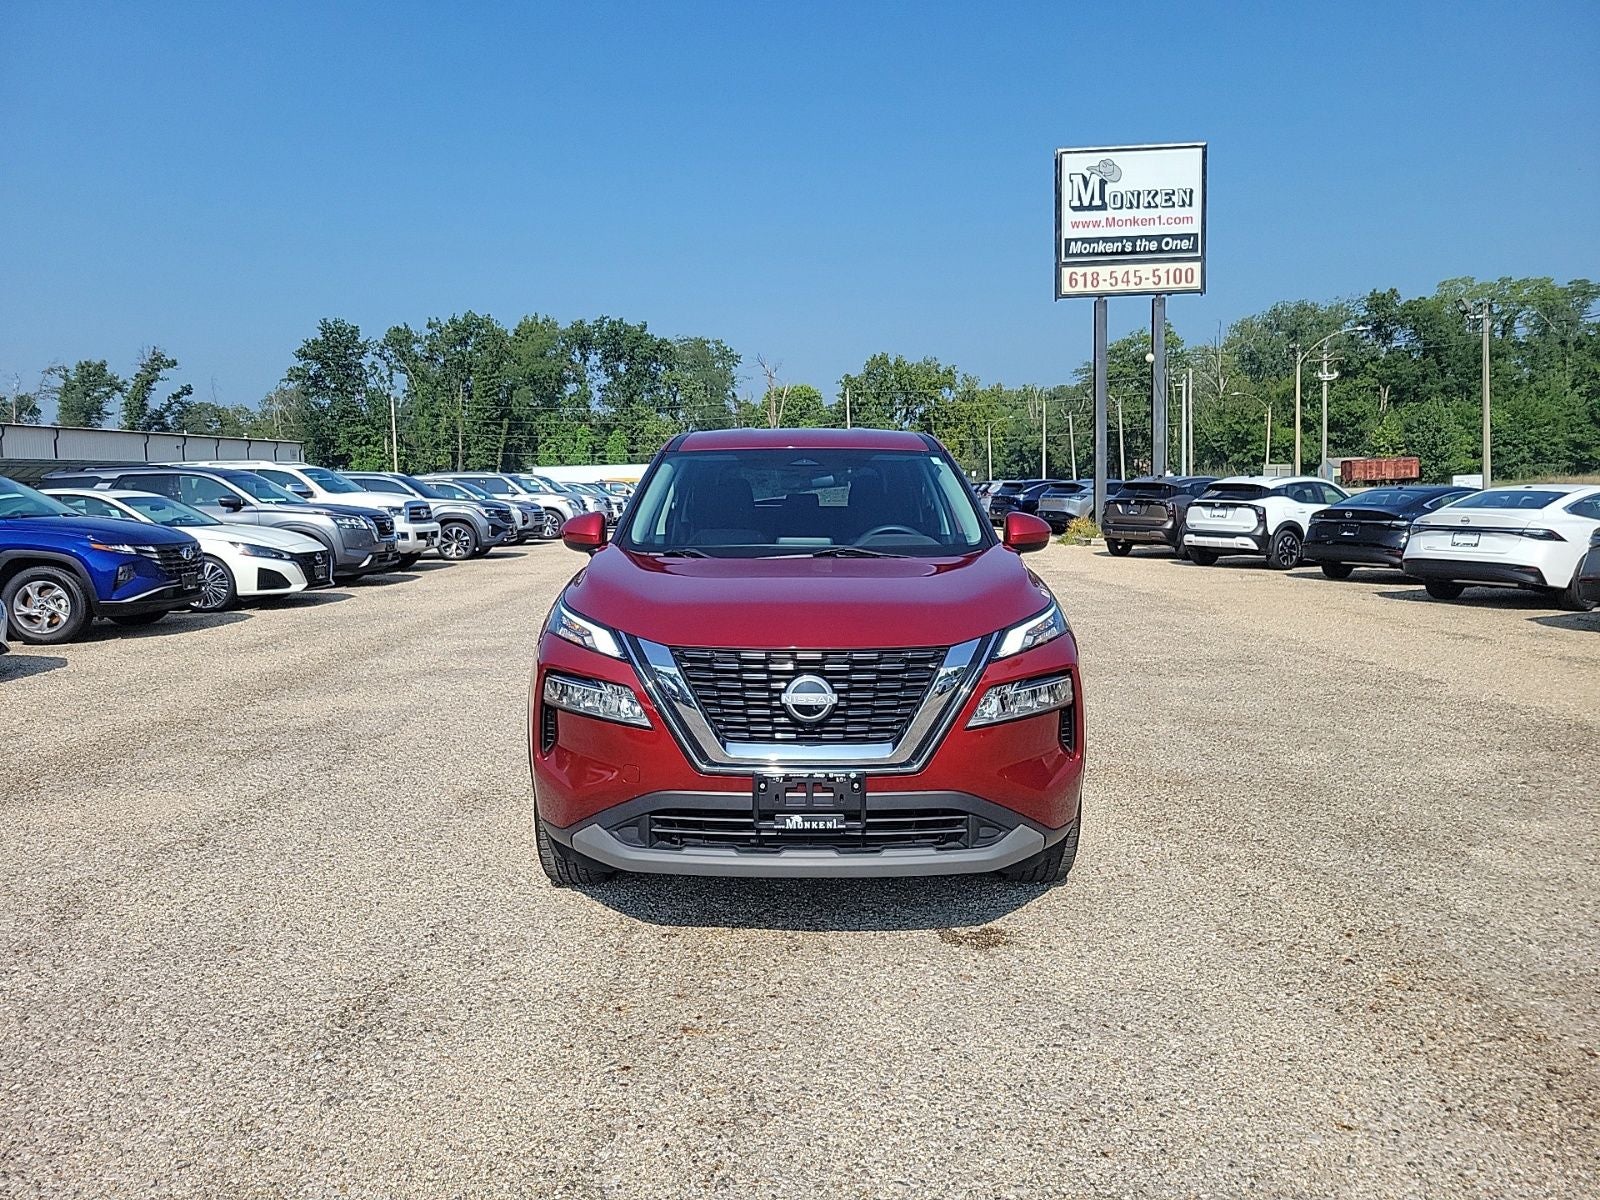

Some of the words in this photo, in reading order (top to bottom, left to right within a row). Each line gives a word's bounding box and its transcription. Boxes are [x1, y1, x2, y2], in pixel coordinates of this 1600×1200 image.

[1069, 173, 1193, 212] MONKEN
[1070, 215, 1194, 229] www.Monken1.com
[1068, 239, 1133, 254] Monken's
[1136, 239, 1158, 252] the
[1161, 236, 1194, 251] One!
[1068, 267, 1194, 289] 618-545-5100
